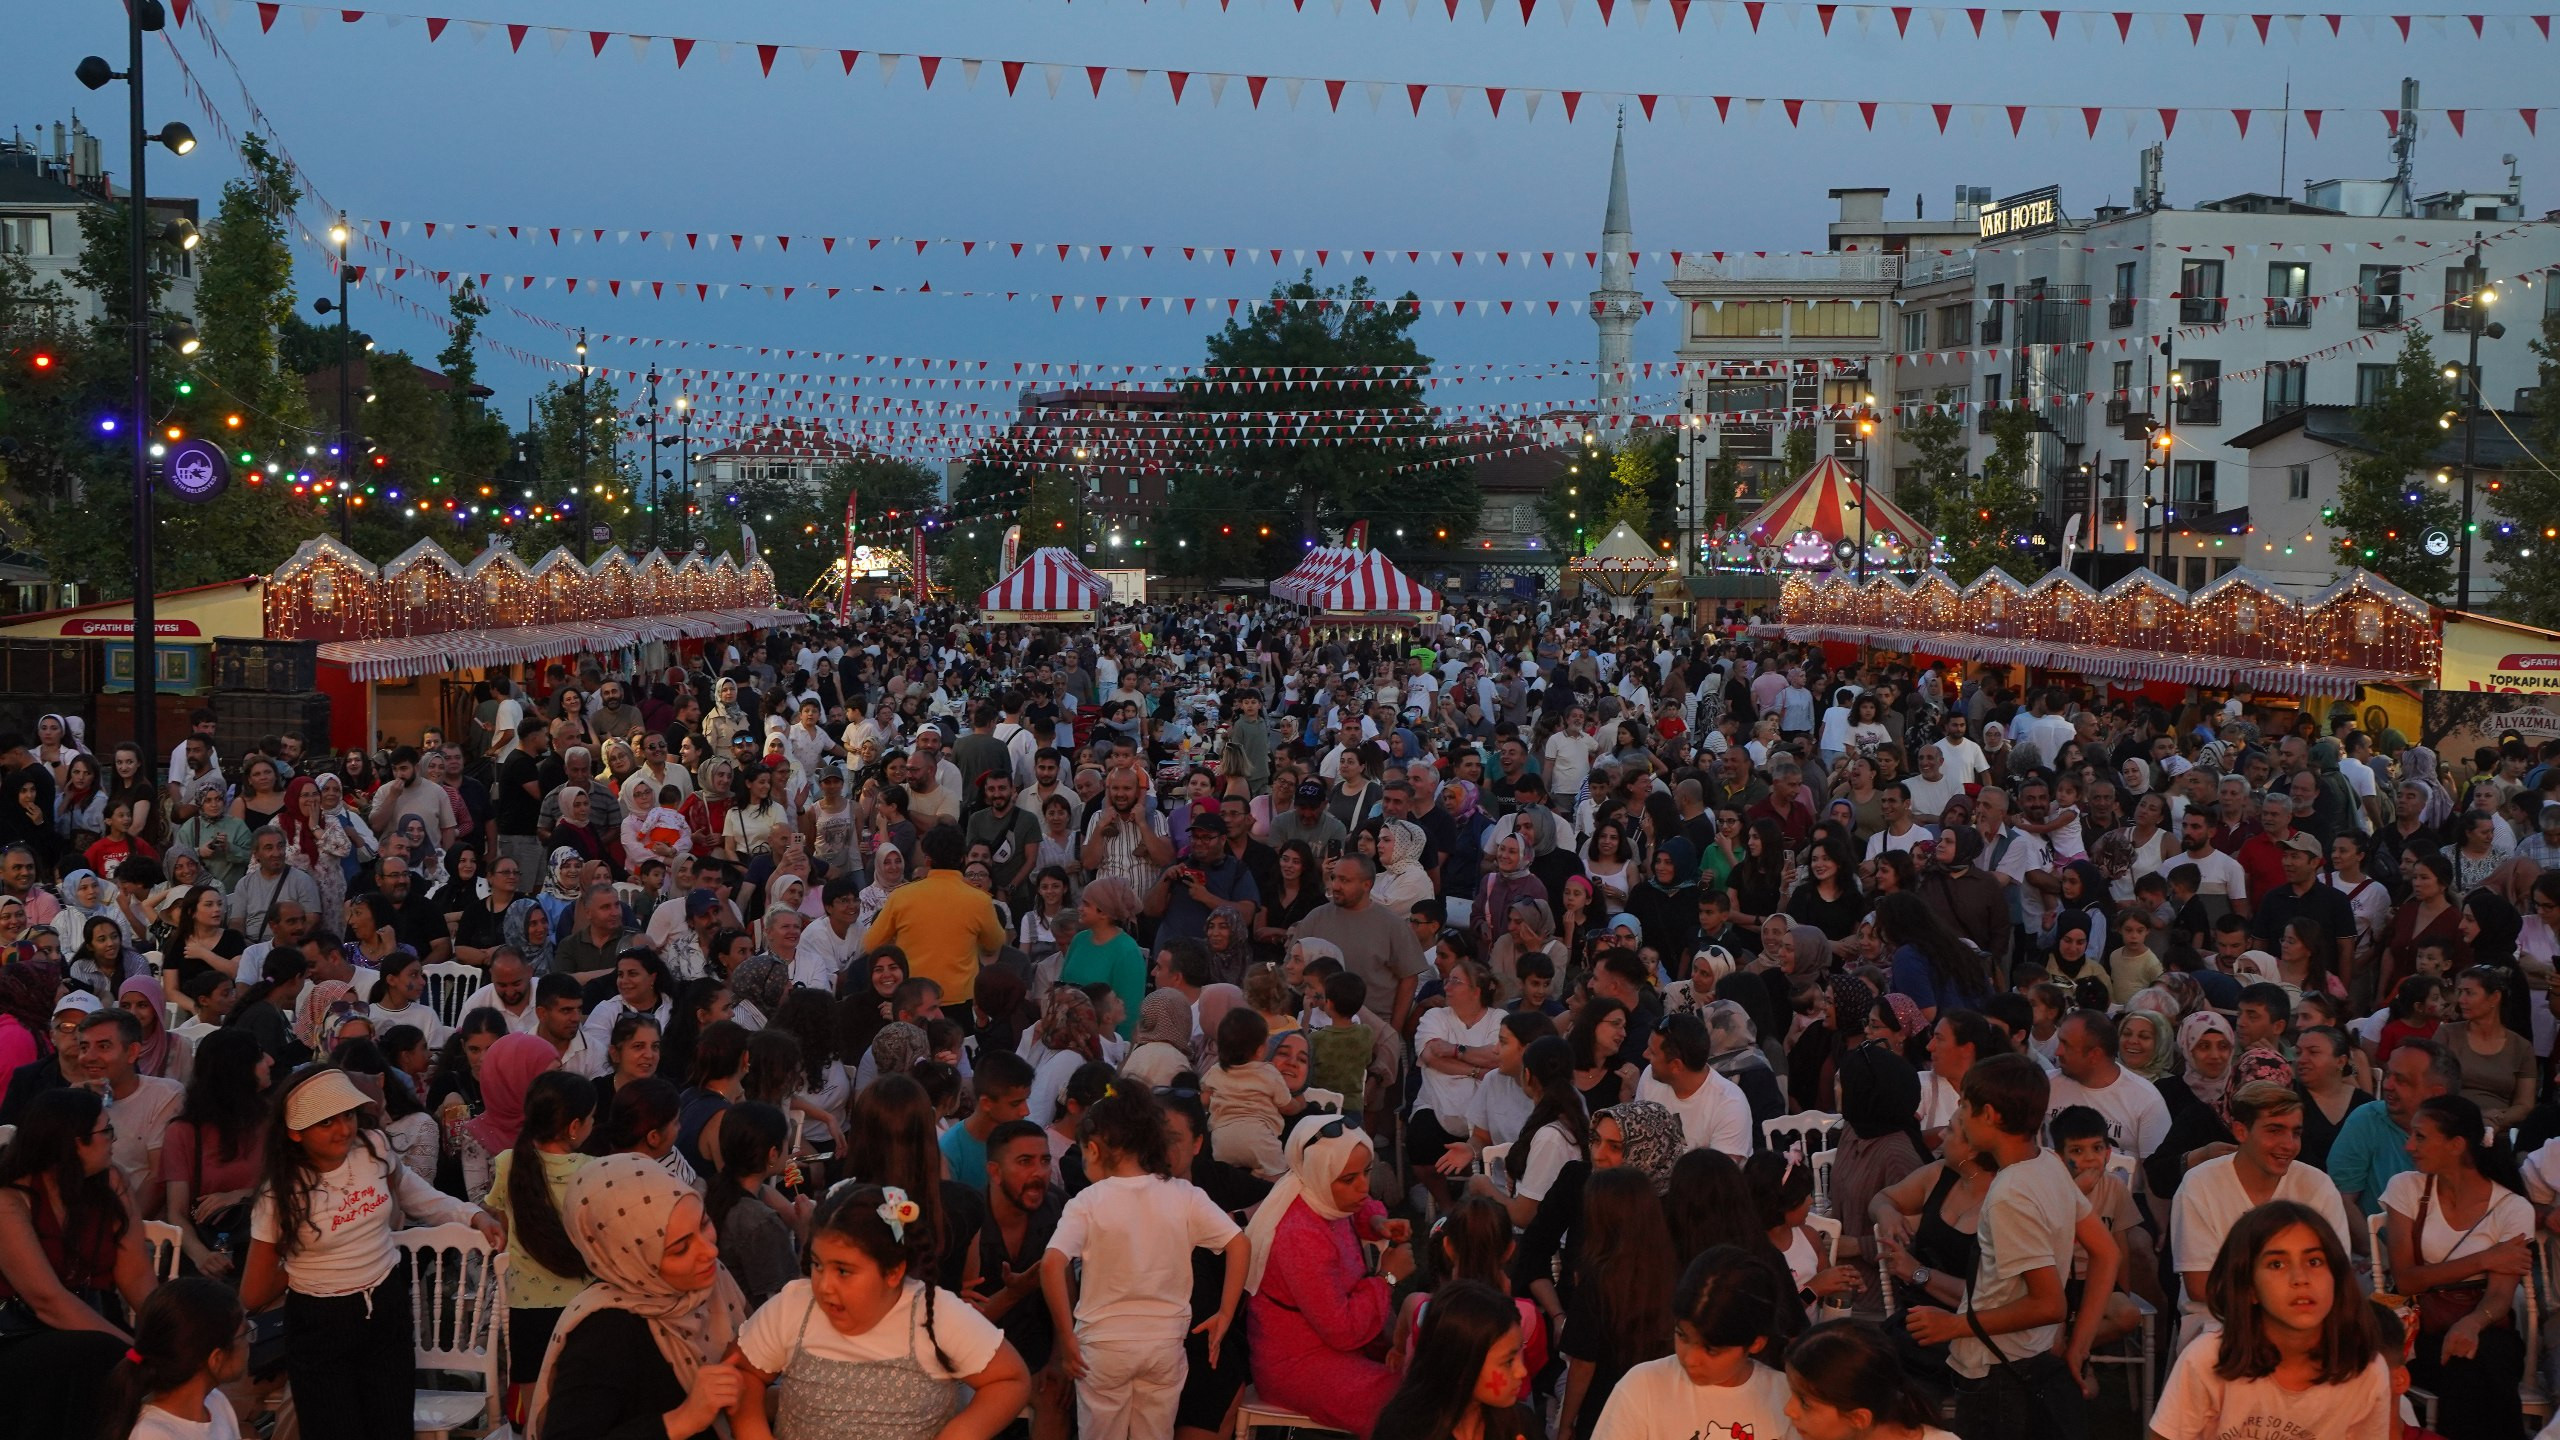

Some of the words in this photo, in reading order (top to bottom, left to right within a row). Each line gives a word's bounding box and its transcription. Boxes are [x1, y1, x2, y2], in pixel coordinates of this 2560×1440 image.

[1979, 210, 2007, 238] VARI
[2010, 199, 2055, 231] HOTEL
[2489, 674, 2540, 688] TOPKAPI
[2543, 677, 2560, 688] KA
[2495, 716, 2560, 731] ALYAZMAL
[338, 1190, 360, 1212] Not
[361, 1186, 376, 1198] my
[2266, 1416, 2282, 1428] SO
